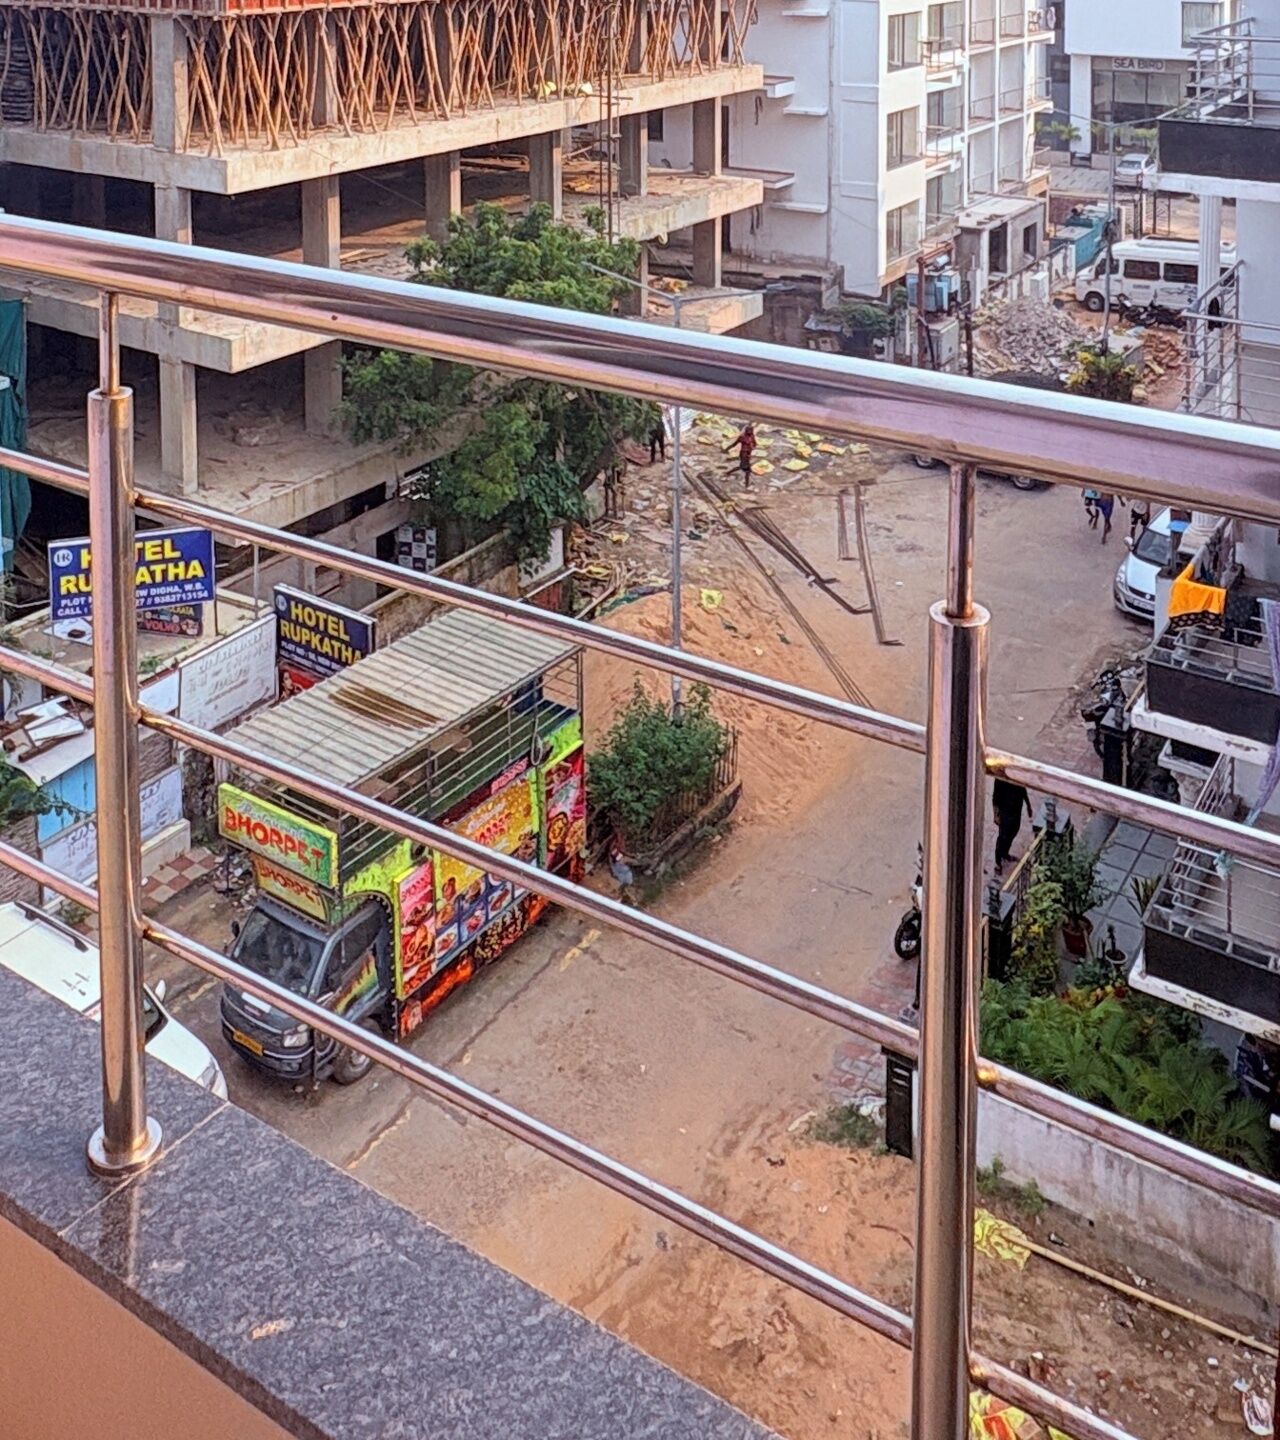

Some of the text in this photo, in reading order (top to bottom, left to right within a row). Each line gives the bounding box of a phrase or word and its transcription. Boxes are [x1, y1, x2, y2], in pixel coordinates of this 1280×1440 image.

[81, 539, 182, 569] HTEL
[60, 559, 205, 596] RUATHA
[280, 618, 363, 666] RUPKATHA
[290, 600, 350, 642] HOTEL
[224, 805, 325, 872] BHORPET
